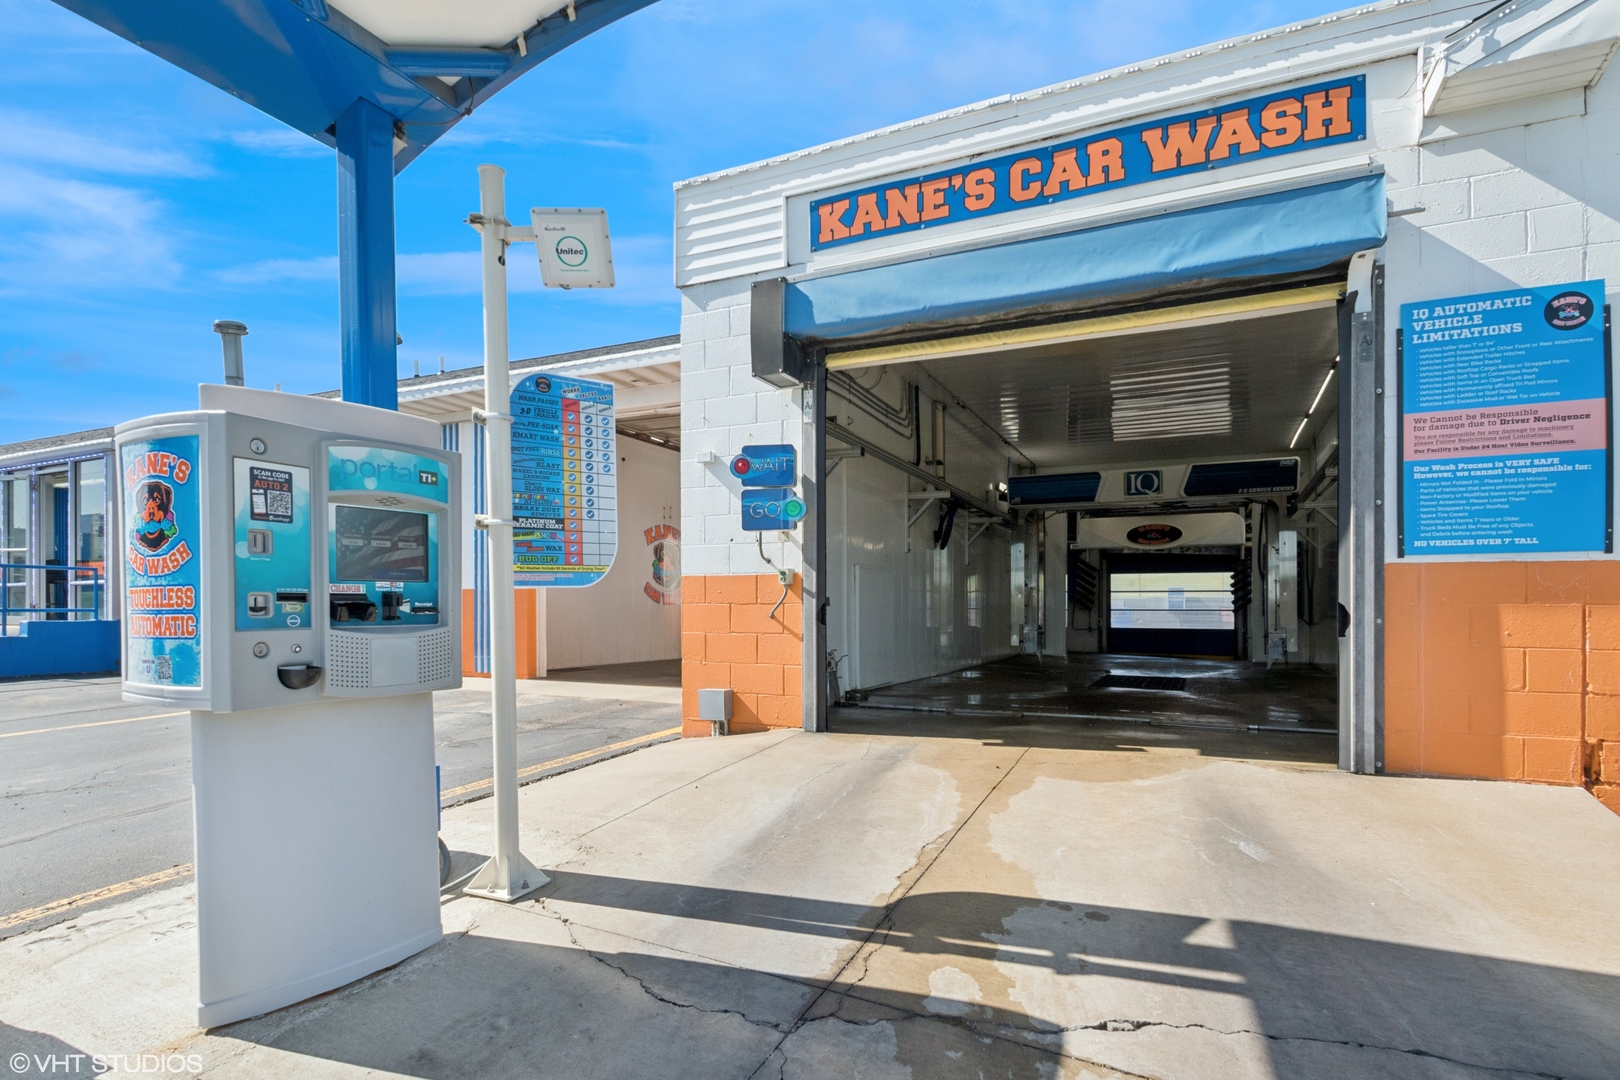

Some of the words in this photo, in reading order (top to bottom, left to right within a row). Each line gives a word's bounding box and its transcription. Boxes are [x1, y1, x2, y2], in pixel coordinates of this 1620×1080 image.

[818, 167, 996, 244] KANE'S
[1009, 137, 1126, 202] CAR
[1141, 84, 1352, 173] WASH
[556, 247, 584, 255] Unitec
[1412, 308, 1429, 321] IQ
[1433, 295, 1532, 317] AUTOMATIC
[1413, 314, 1482, 332] VEHICLE
[1412, 322, 1522, 344] LIMITATIONS
[1457, 347, 1488, 356] Snowplows
[1554, 336, 1593, 345] Attachments
[1429, 422, 1465, 432] damage
[1500, 417, 1530, 425] Driver
[1534, 413, 1591, 424] Negligence
[1430, 415, 1463, 423] Cannot
[1480, 409, 1538, 420] Responsible
[513, 432, 538, 440] SMART
[1439, 431, 1475, 439] responsible
[1538, 424, 1574, 432] machinery
[540, 448, 561, 456] RINSE
[126, 451, 191, 490] KANE'S
[340, 458, 416, 484] portal
[750, 456, 790, 472] WAIT
[1414, 471, 1454, 480] However,
[1518, 464, 1572, 474] responsible
[254, 480, 280, 490] AUTO
[1129, 472, 1160, 495] IQ
[750, 501, 780, 518] GO
[128, 544, 145, 575] CAR
[146, 540, 192, 576] WASH
[129, 586, 194, 610] TOUCHLESS
[129, 614, 196, 638] AUTOMATIC
